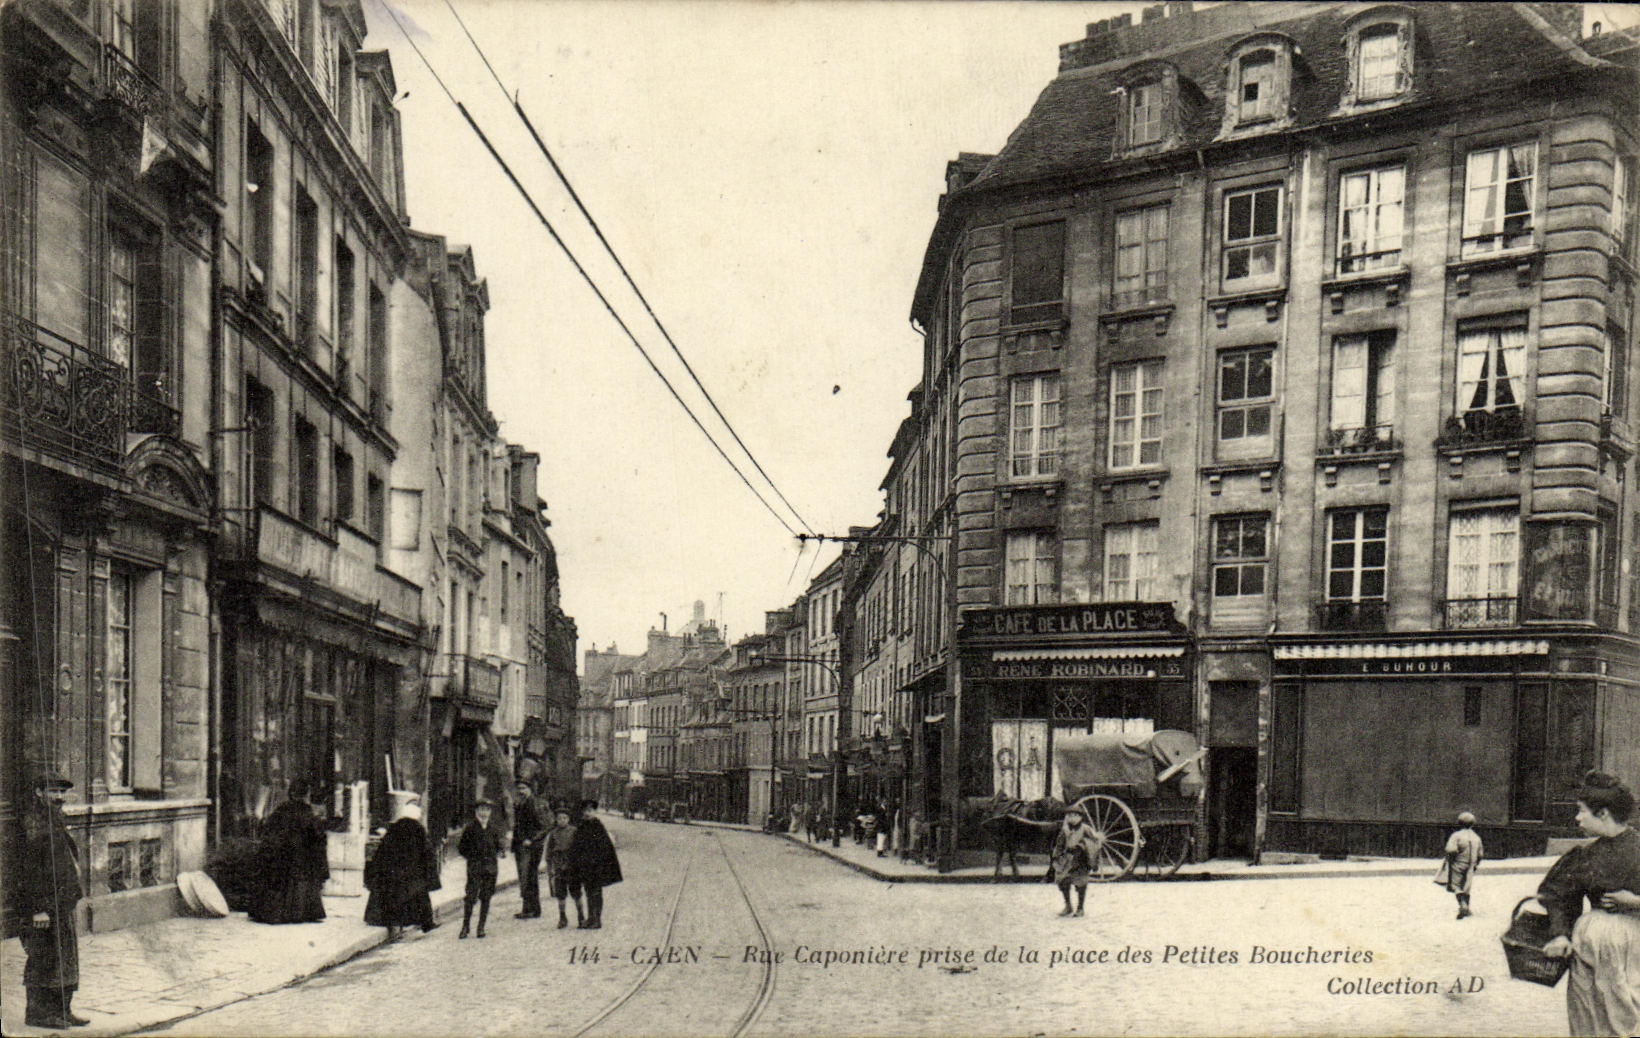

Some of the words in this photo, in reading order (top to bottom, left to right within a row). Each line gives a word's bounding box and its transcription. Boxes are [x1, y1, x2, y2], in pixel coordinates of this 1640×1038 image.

[1038, 616, 1057, 632] DE
[1061, 615, 1079, 632] LA
[1082, 609, 1138, 630] PLACE
[1051, 663, 1144, 677] ROBINARD
